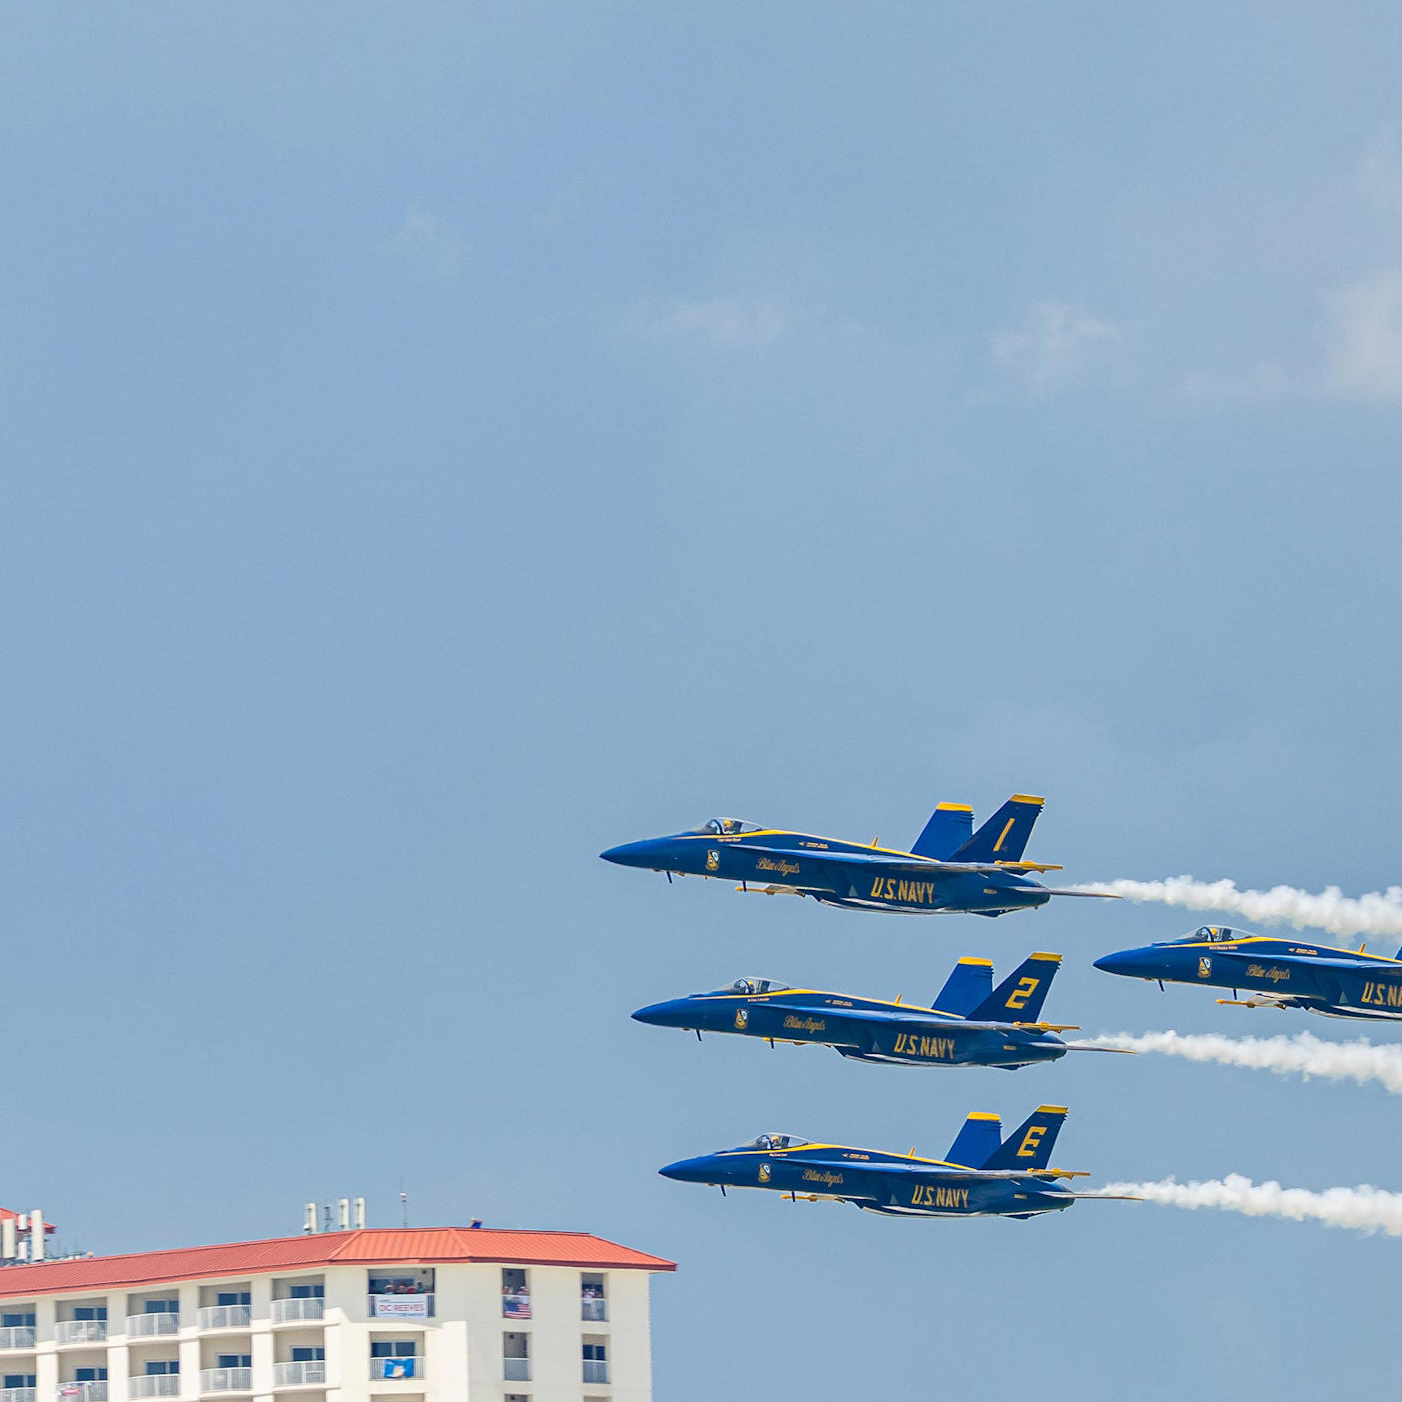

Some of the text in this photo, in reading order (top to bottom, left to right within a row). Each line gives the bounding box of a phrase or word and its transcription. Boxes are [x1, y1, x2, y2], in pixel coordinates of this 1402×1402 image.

[993, 817, 1015, 852] 1
[756, 857, 777, 870] Blue
[870, 876, 935, 904] U.S. NAVY
[1245, 963, 1265, 977] Blue
[1005, 976, 1040, 1009] 2
[1361, 981, 1386, 1006] U.S.
[783, 1015, 802, 1028] Blue
[893, 1032, 955, 1059] U.S. NAVY
[1016, 1126, 1048, 1157] E
[802, 1168, 820, 1181] Blue
[911, 1184, 969, 1208] U.S. NAVY
